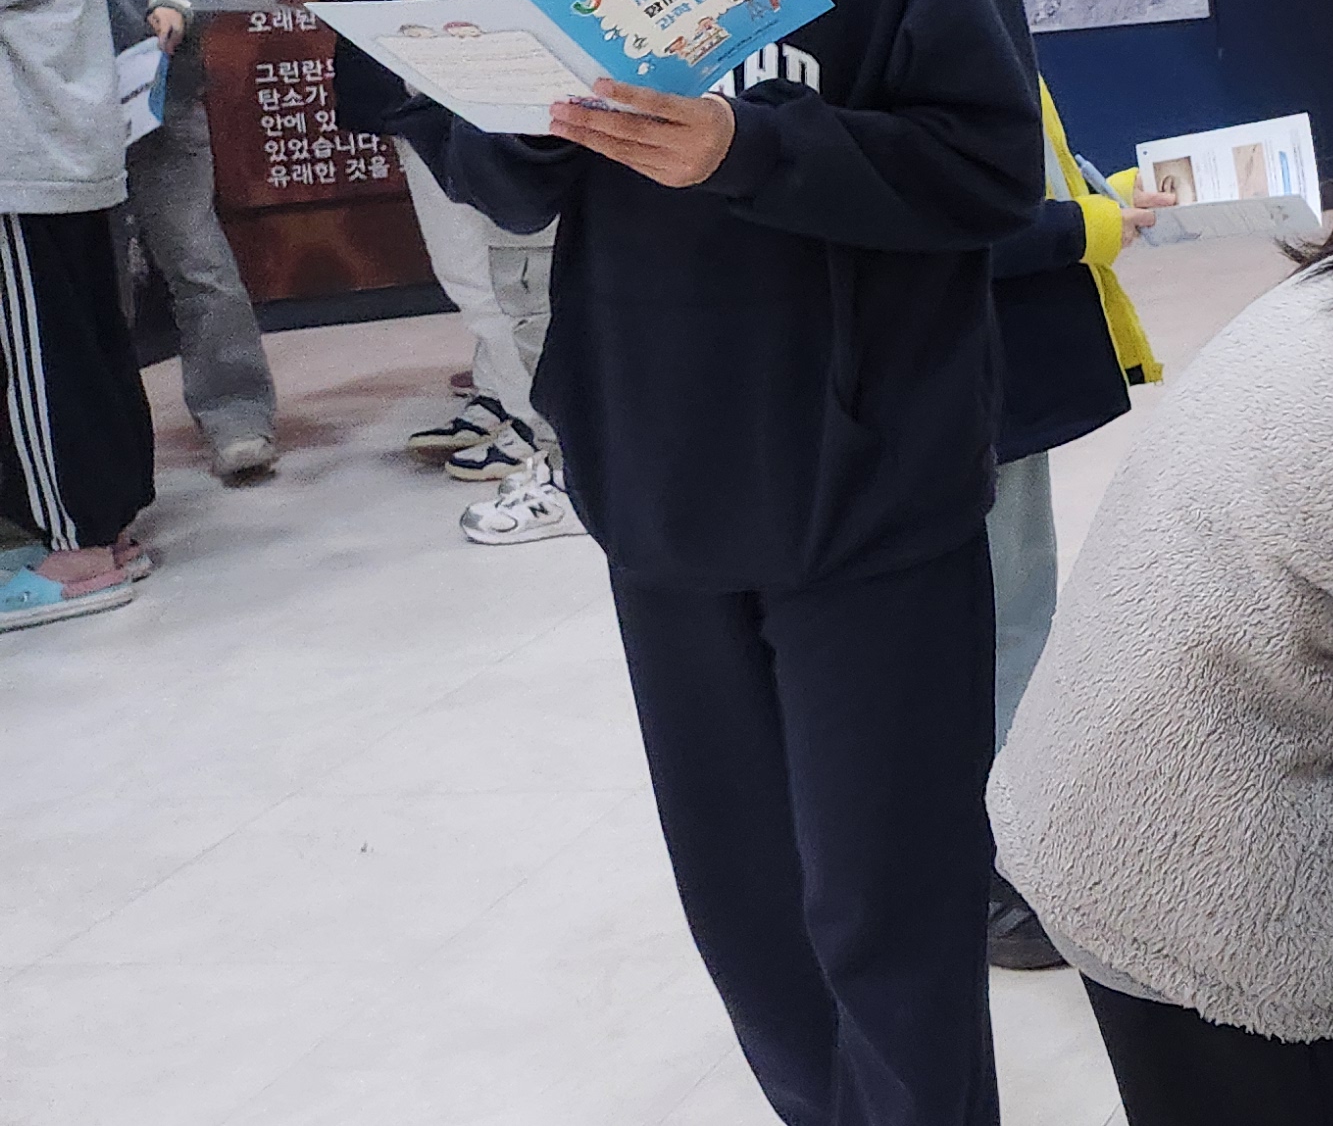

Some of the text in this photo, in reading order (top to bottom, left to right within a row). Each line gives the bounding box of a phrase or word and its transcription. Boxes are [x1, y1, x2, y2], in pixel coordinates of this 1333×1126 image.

[260, 112, 306, 137] 안에
[264, 132, 388, 162] 있었습니다.
[345, 156, 390, 182] 것을
